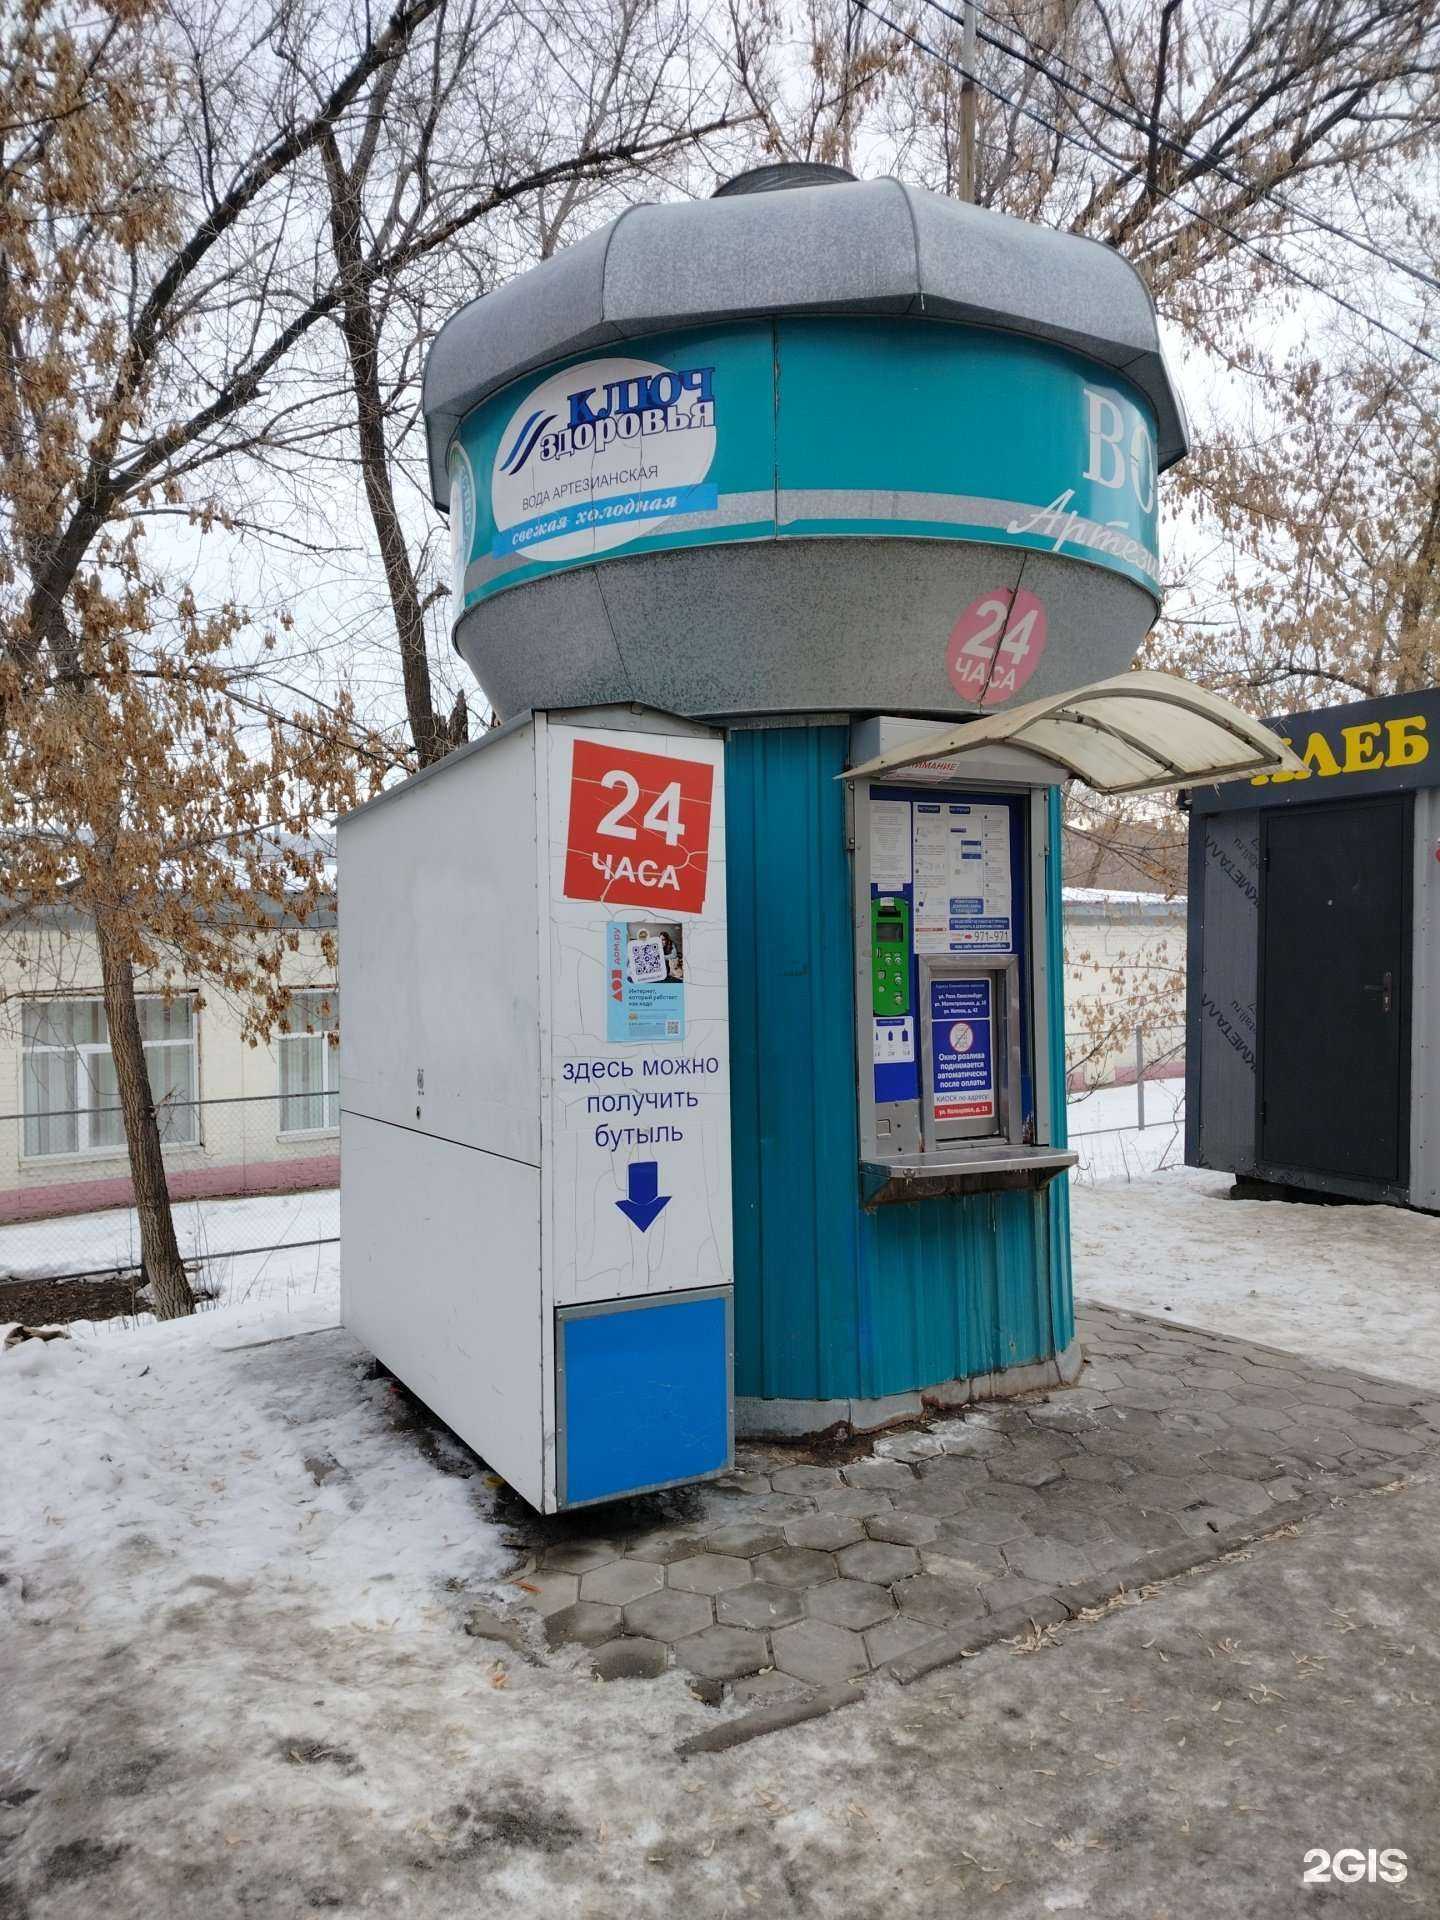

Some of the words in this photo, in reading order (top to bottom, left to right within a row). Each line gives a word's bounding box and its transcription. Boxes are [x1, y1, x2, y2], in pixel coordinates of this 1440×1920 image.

[1082, 388, 1156, 514] ВО
[522, 490, 551, 511] ВОДА
[552, 465, 659, 500] АРТЕЗИАНСКАЯ
[511, 515, 569, 546] свежая
[575, 493, 678, 526] холодная
[963, 600, 1039, 665] 24
[955, 657, 1017, 691] ЧАСА
[596, 769, 686, 847] 24
[592, 851, 681, 891] ЧАСА
[562, 1060, 634, 1084] здесь
[643, 1057, 719, 1076] можно
[938, 1053, 957, 1061] Окно
[957, 1052, 985, 1062] розлива
[940, 1061, 985, 1071] поднимается
[937, 1070, 988, 1080] автоматически
[960, 1079, 986, 1087] оплаты
[587, 1091, 699, 1117] получить
[595, 1123, 684, 1152] бутыль
